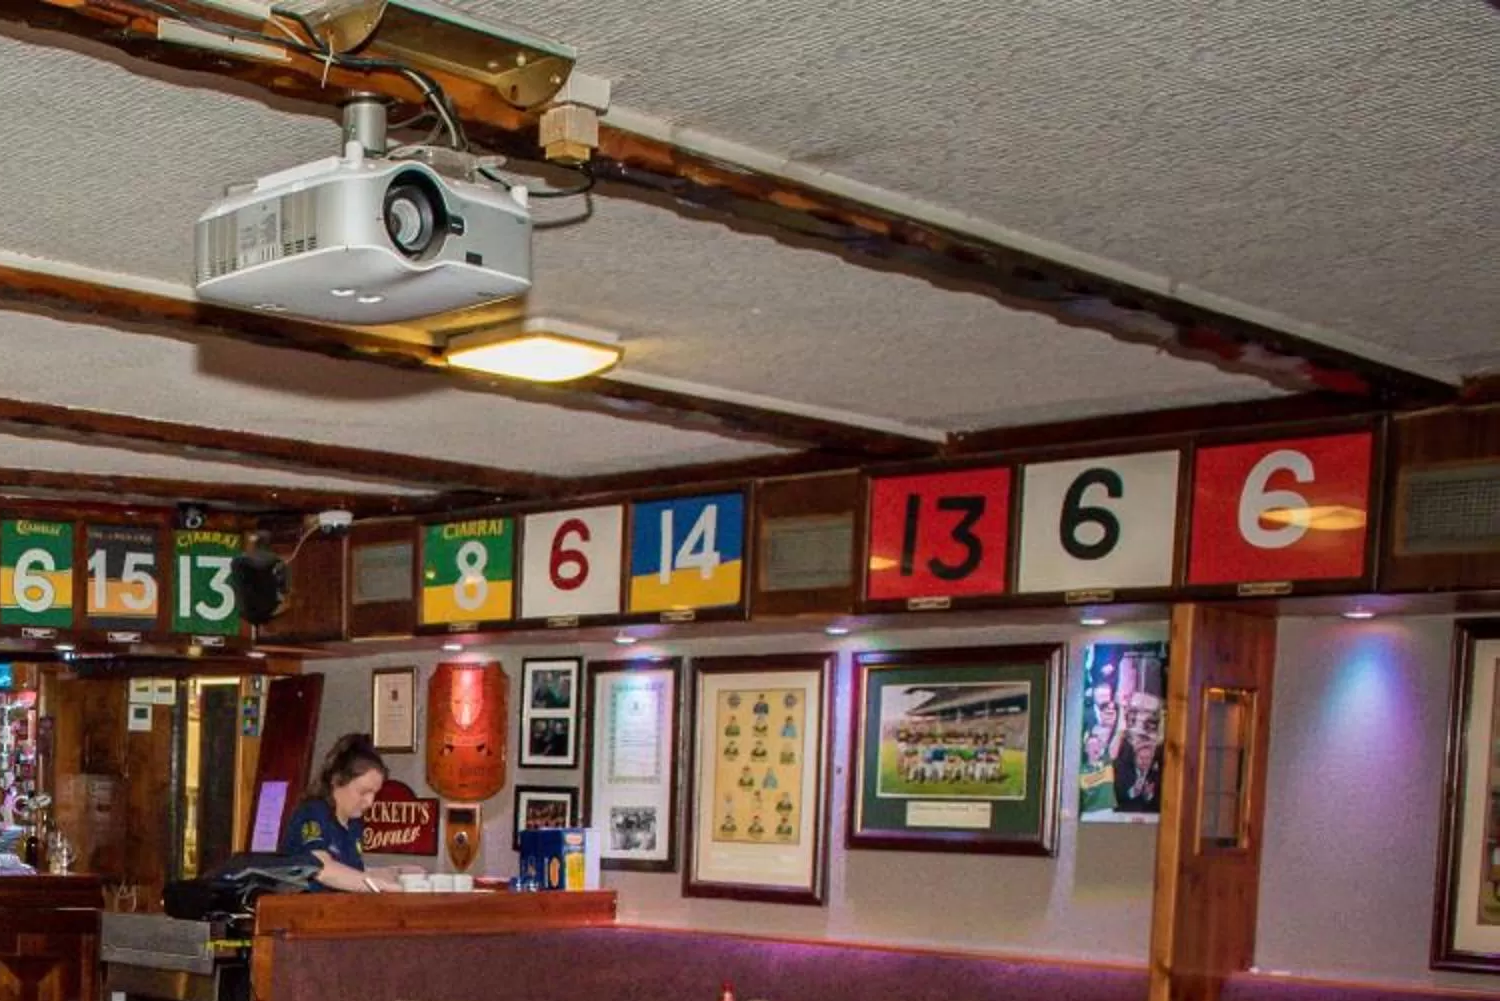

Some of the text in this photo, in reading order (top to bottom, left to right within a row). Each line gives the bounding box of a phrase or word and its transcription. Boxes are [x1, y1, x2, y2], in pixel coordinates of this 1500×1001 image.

[1060, 467, 1124, 561] 6
[1237, 448, 1316, 549] 6
[549, 519, 591, 590] 6
[659, 503, 721, 586] 14
[902, 493, 987, 580] 13
[13, 549, 56, 613] 6
[87, 549, 157, 611] 15
[179, 556, 236, 621] 13
[453, 541, 489, 611] 8
